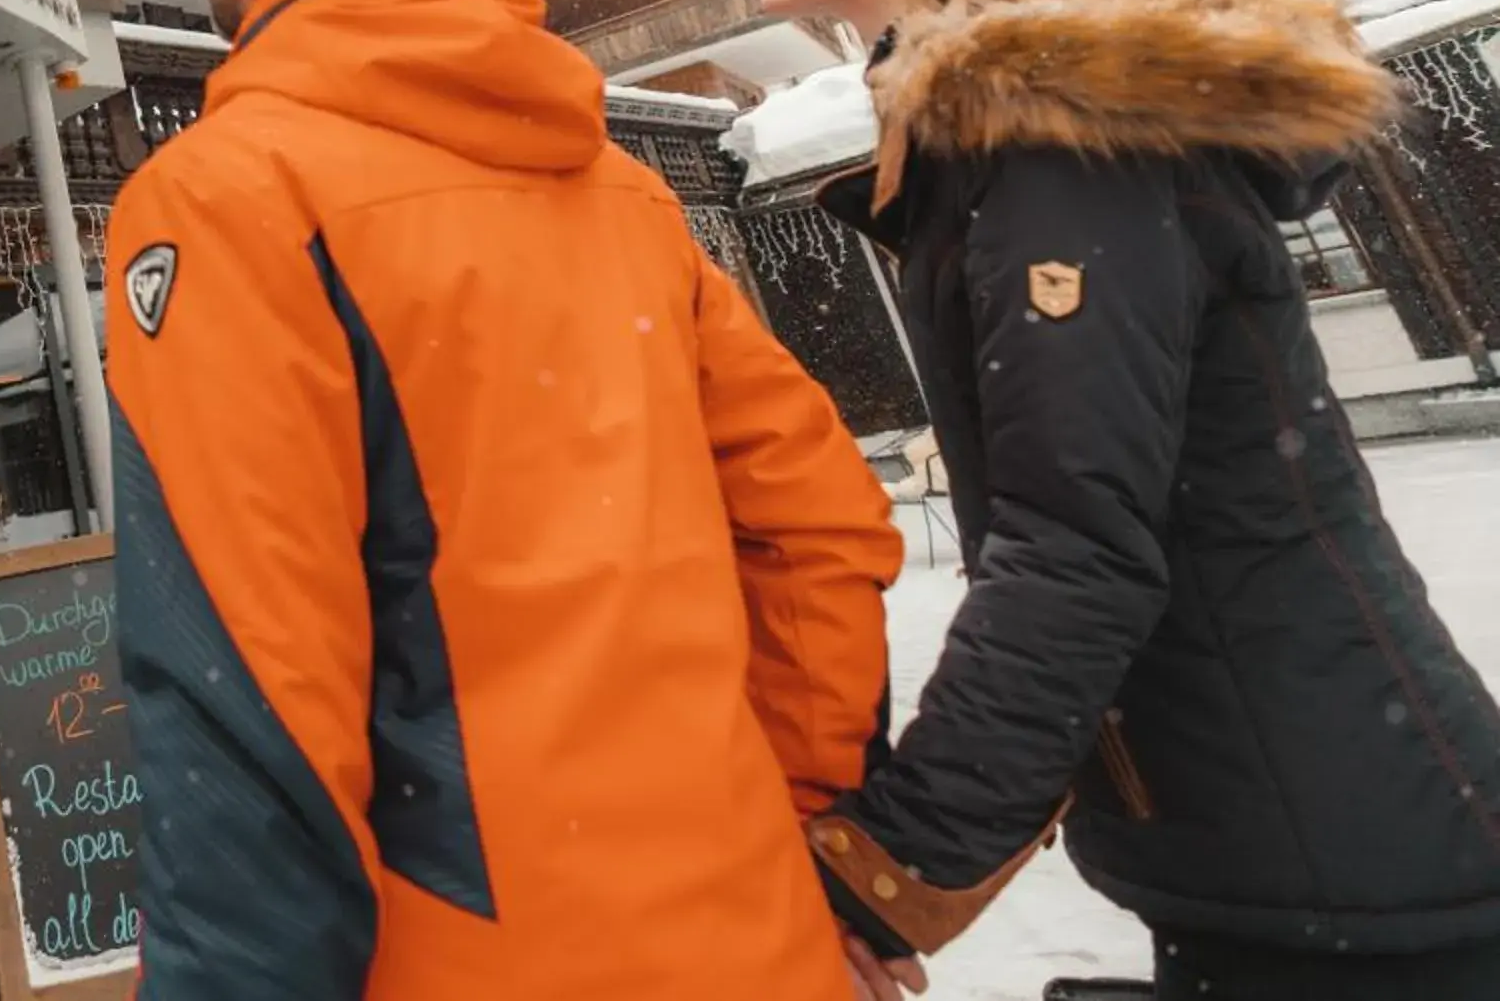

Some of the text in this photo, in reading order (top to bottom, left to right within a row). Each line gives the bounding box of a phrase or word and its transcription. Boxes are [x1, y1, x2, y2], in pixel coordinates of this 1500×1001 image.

[0, 644, 97, 687] warme
[21, 761, 144, 818] Resta
[62, 828, 133, 892] open
[43, 891, 102, 954] all
